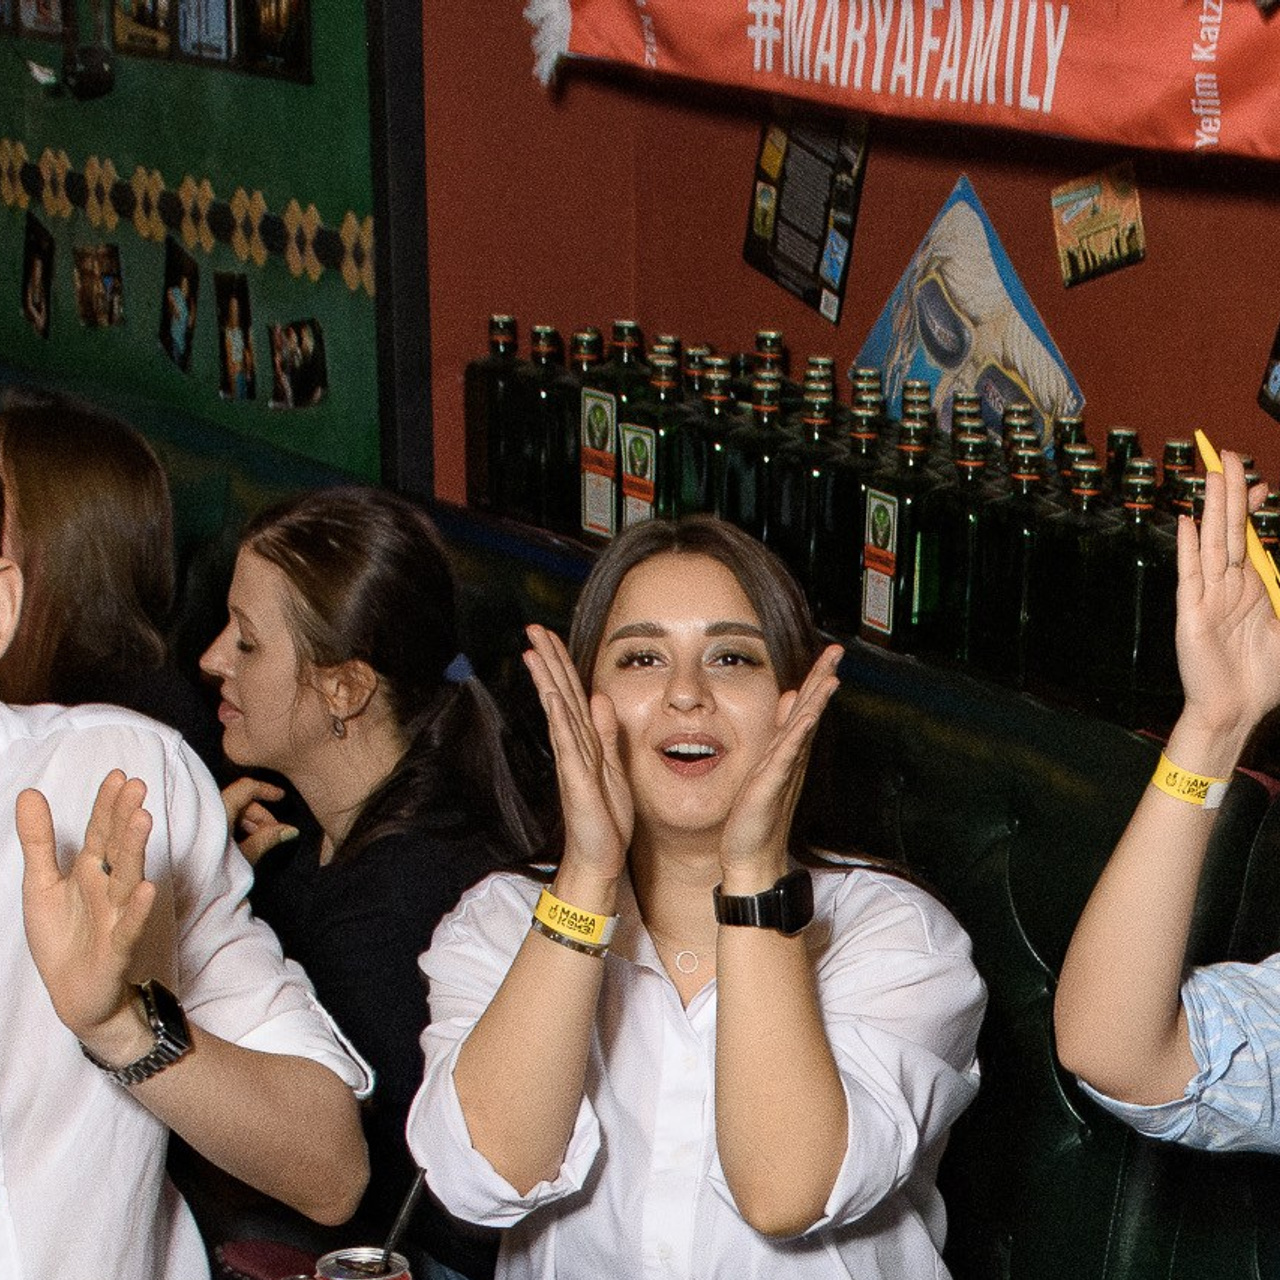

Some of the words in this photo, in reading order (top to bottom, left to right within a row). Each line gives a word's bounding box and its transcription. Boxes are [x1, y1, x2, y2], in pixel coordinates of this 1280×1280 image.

[747, 0, 1070, 114] #MARYAFAMILY
[1191, 72, 1221, 149] Yefim
[561, 907, 596, 926] МАМА
